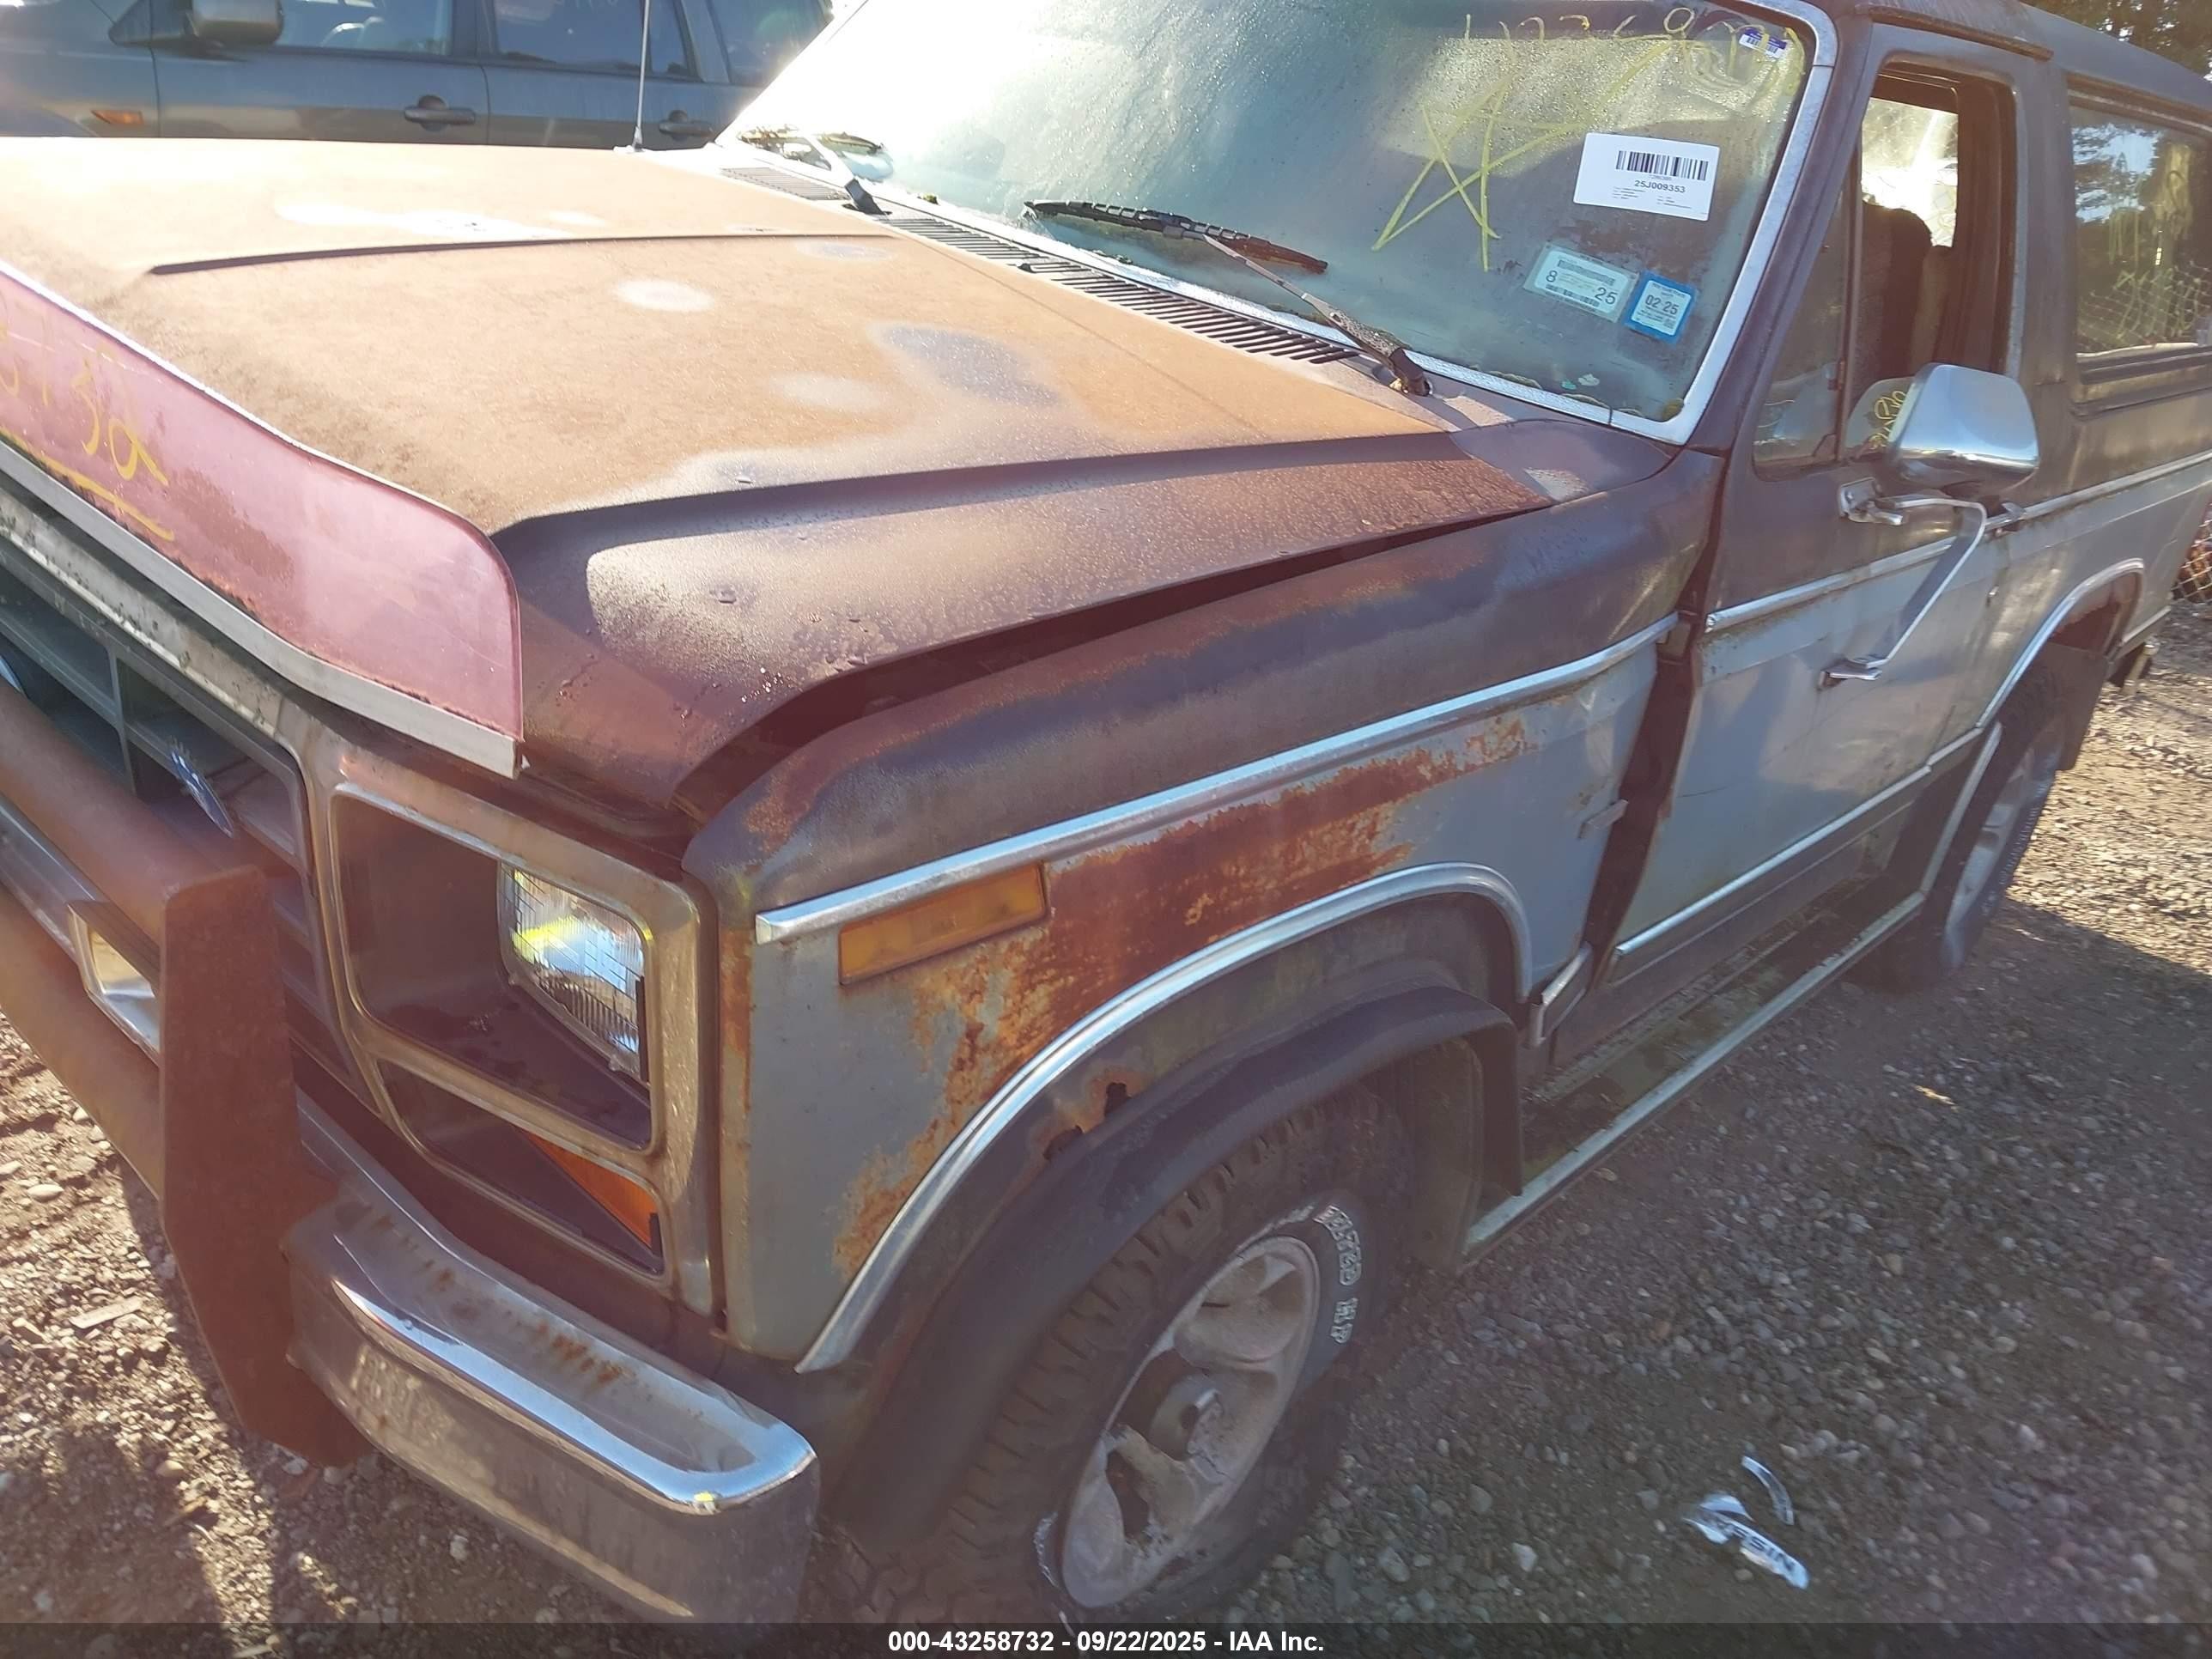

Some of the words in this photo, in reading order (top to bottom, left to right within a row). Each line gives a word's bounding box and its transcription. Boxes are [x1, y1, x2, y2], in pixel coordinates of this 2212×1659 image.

[1634, 179, 1686, 193] 25J009353
[1546, 270, 1558, 283] 8
[1595, 287, 1618, 305] 25
